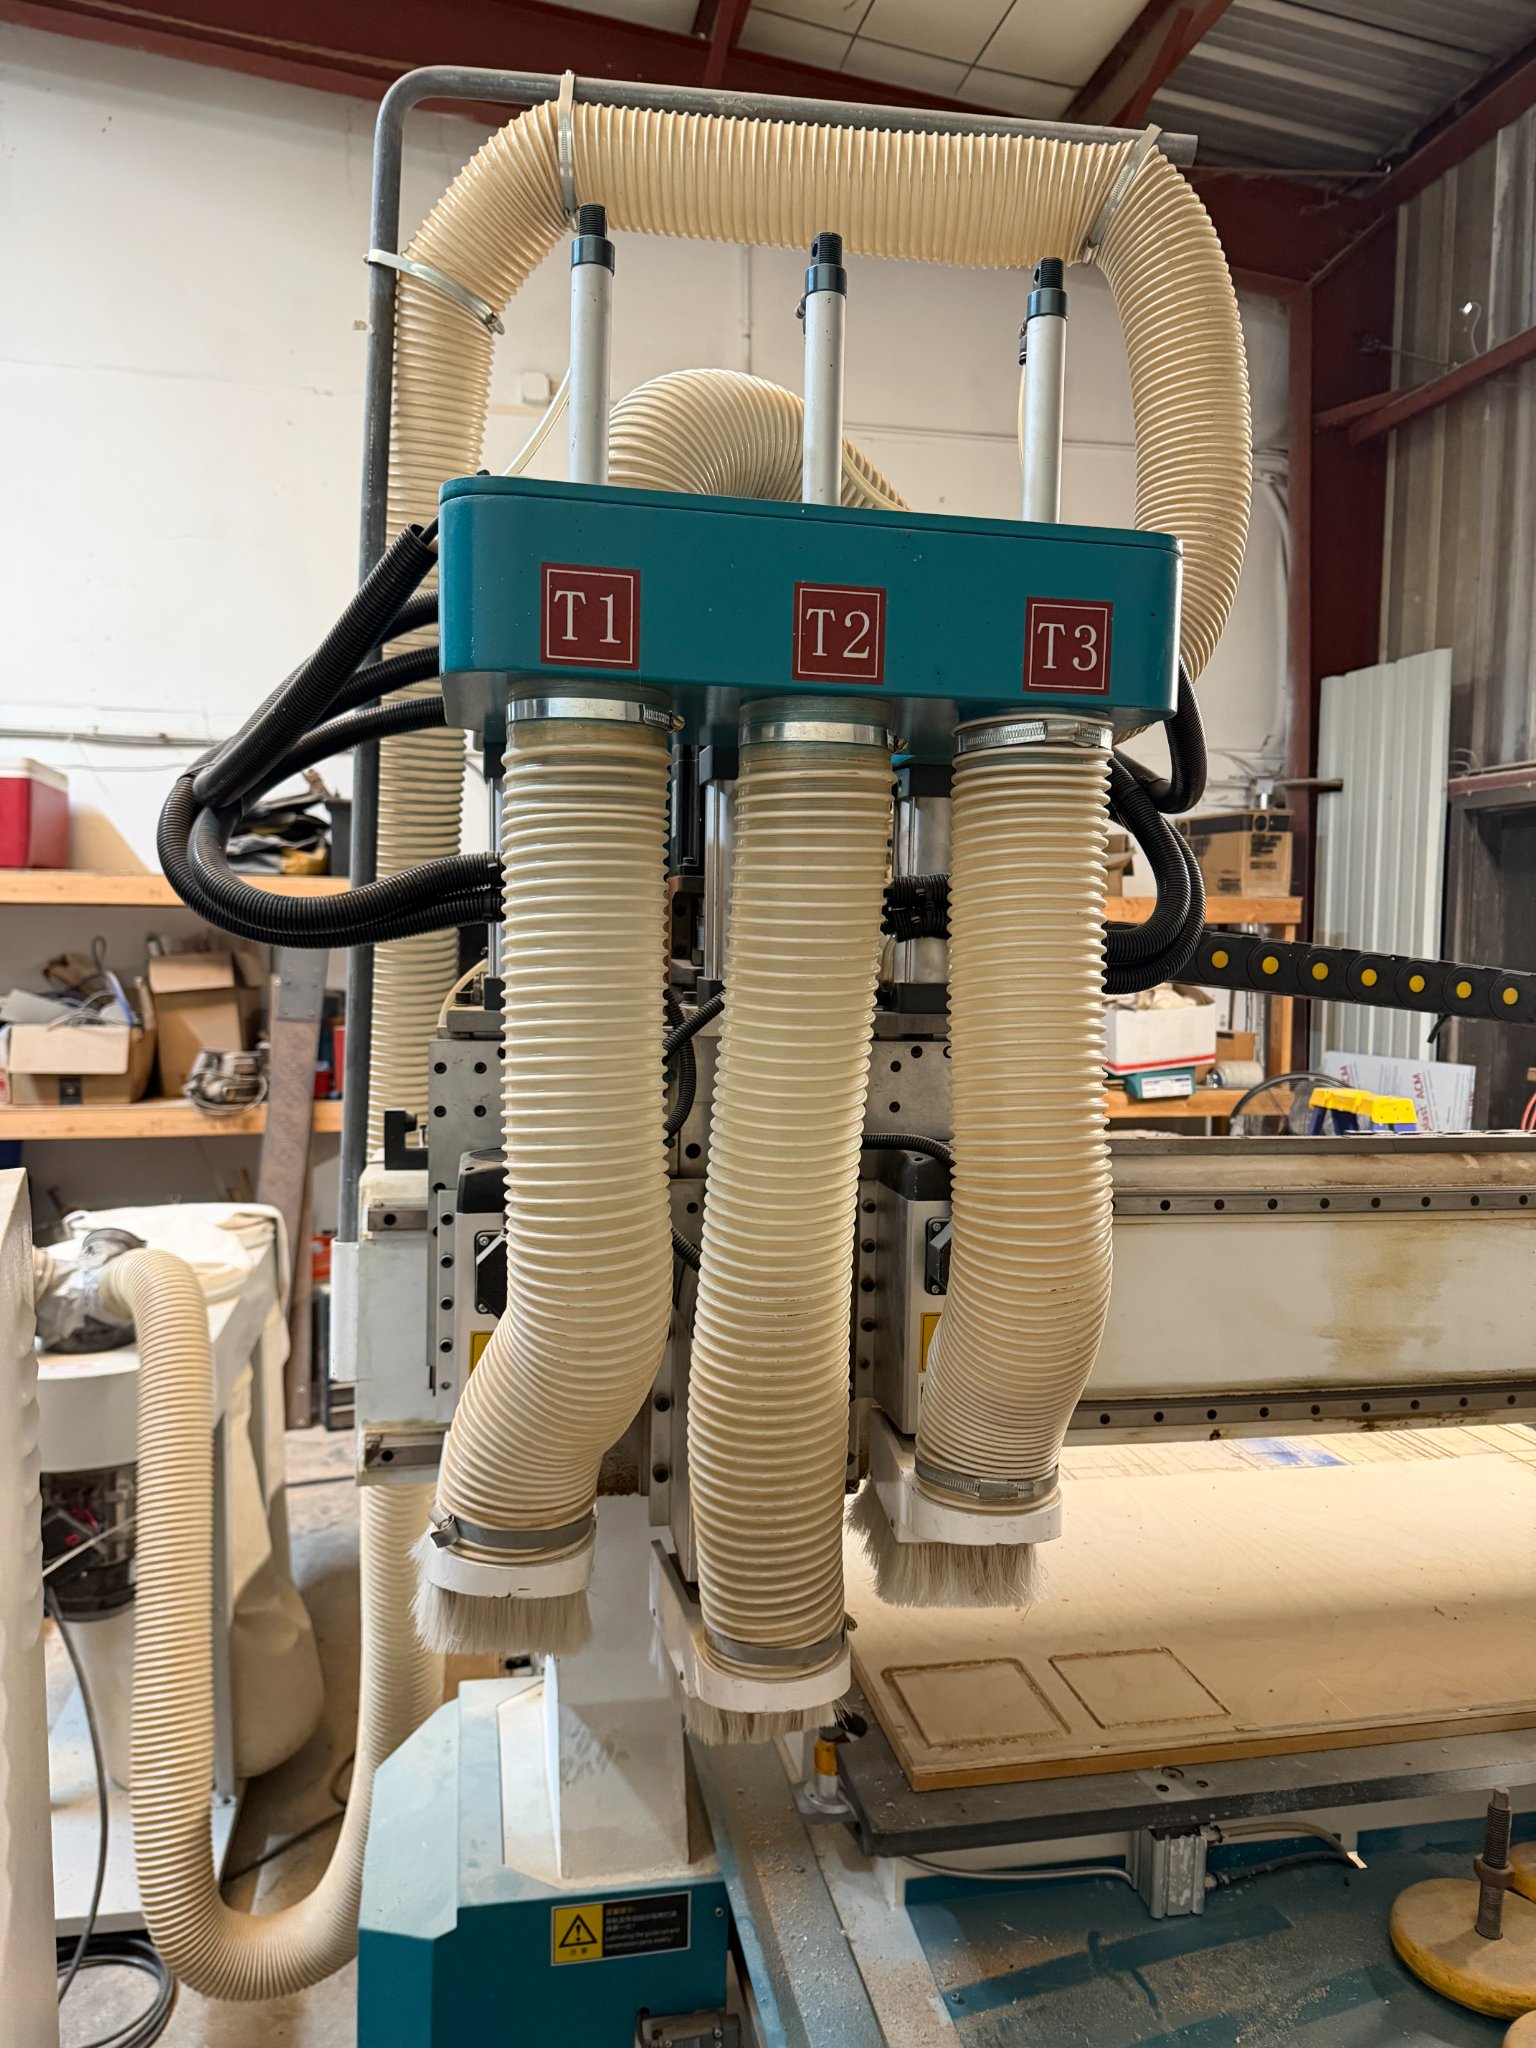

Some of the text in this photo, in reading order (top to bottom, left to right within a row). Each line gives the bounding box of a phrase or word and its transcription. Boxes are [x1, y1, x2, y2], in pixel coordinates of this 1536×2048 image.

[553, 590, 621, 644] T1
[805, 608, 870, 659] T2
[1037, 622, 1098, 671] T3
